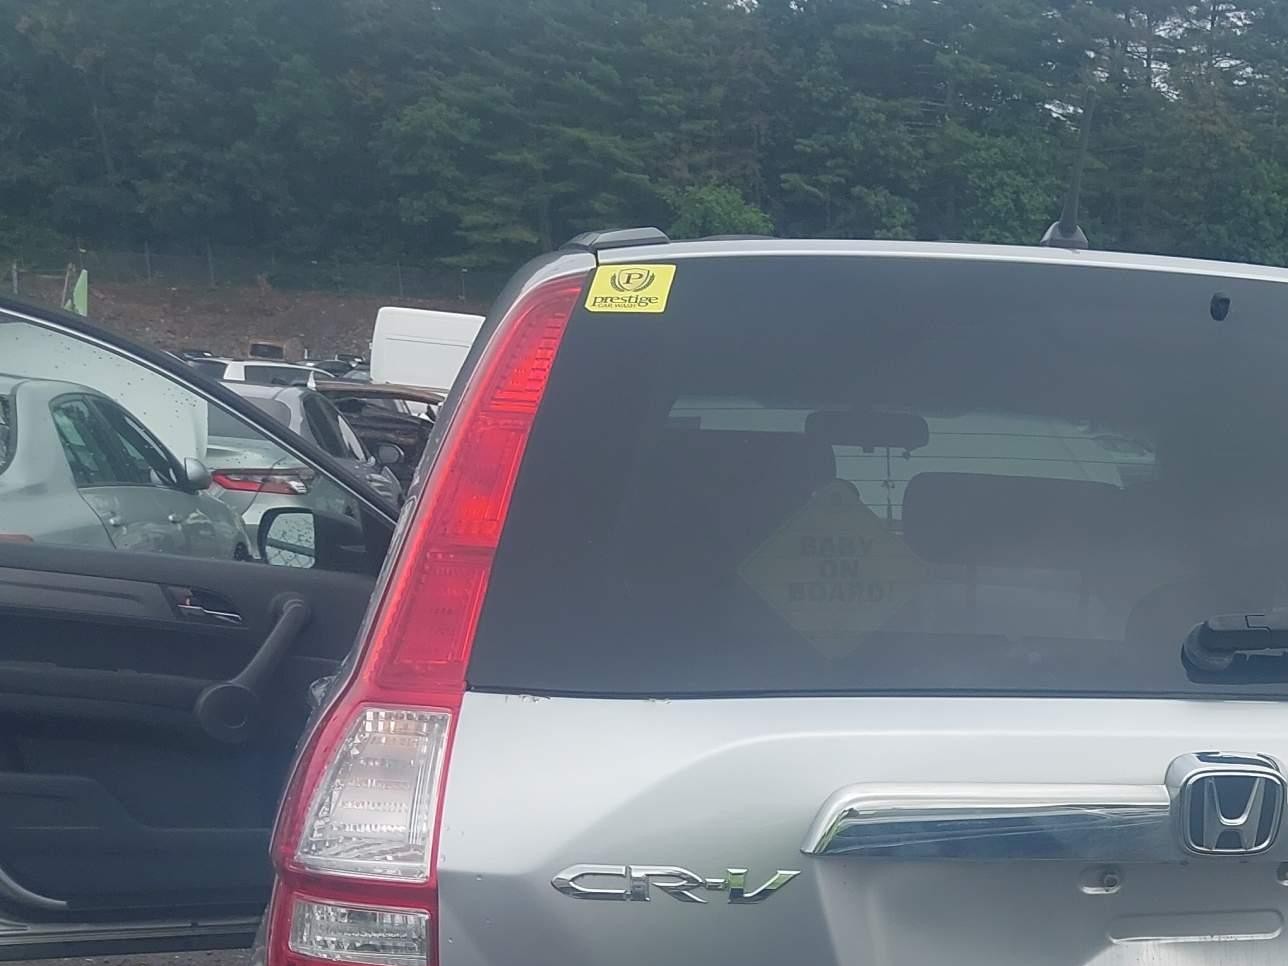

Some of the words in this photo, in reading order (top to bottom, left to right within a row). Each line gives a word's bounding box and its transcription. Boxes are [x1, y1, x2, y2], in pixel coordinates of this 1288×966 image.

[622, 272, 643, 285] P
[592, 294, 659, 308] prestige
[799, 535, 873, 556] BABY
[819, 559, 860, 579] ON
[550, 863, 801, 905] CR-V
